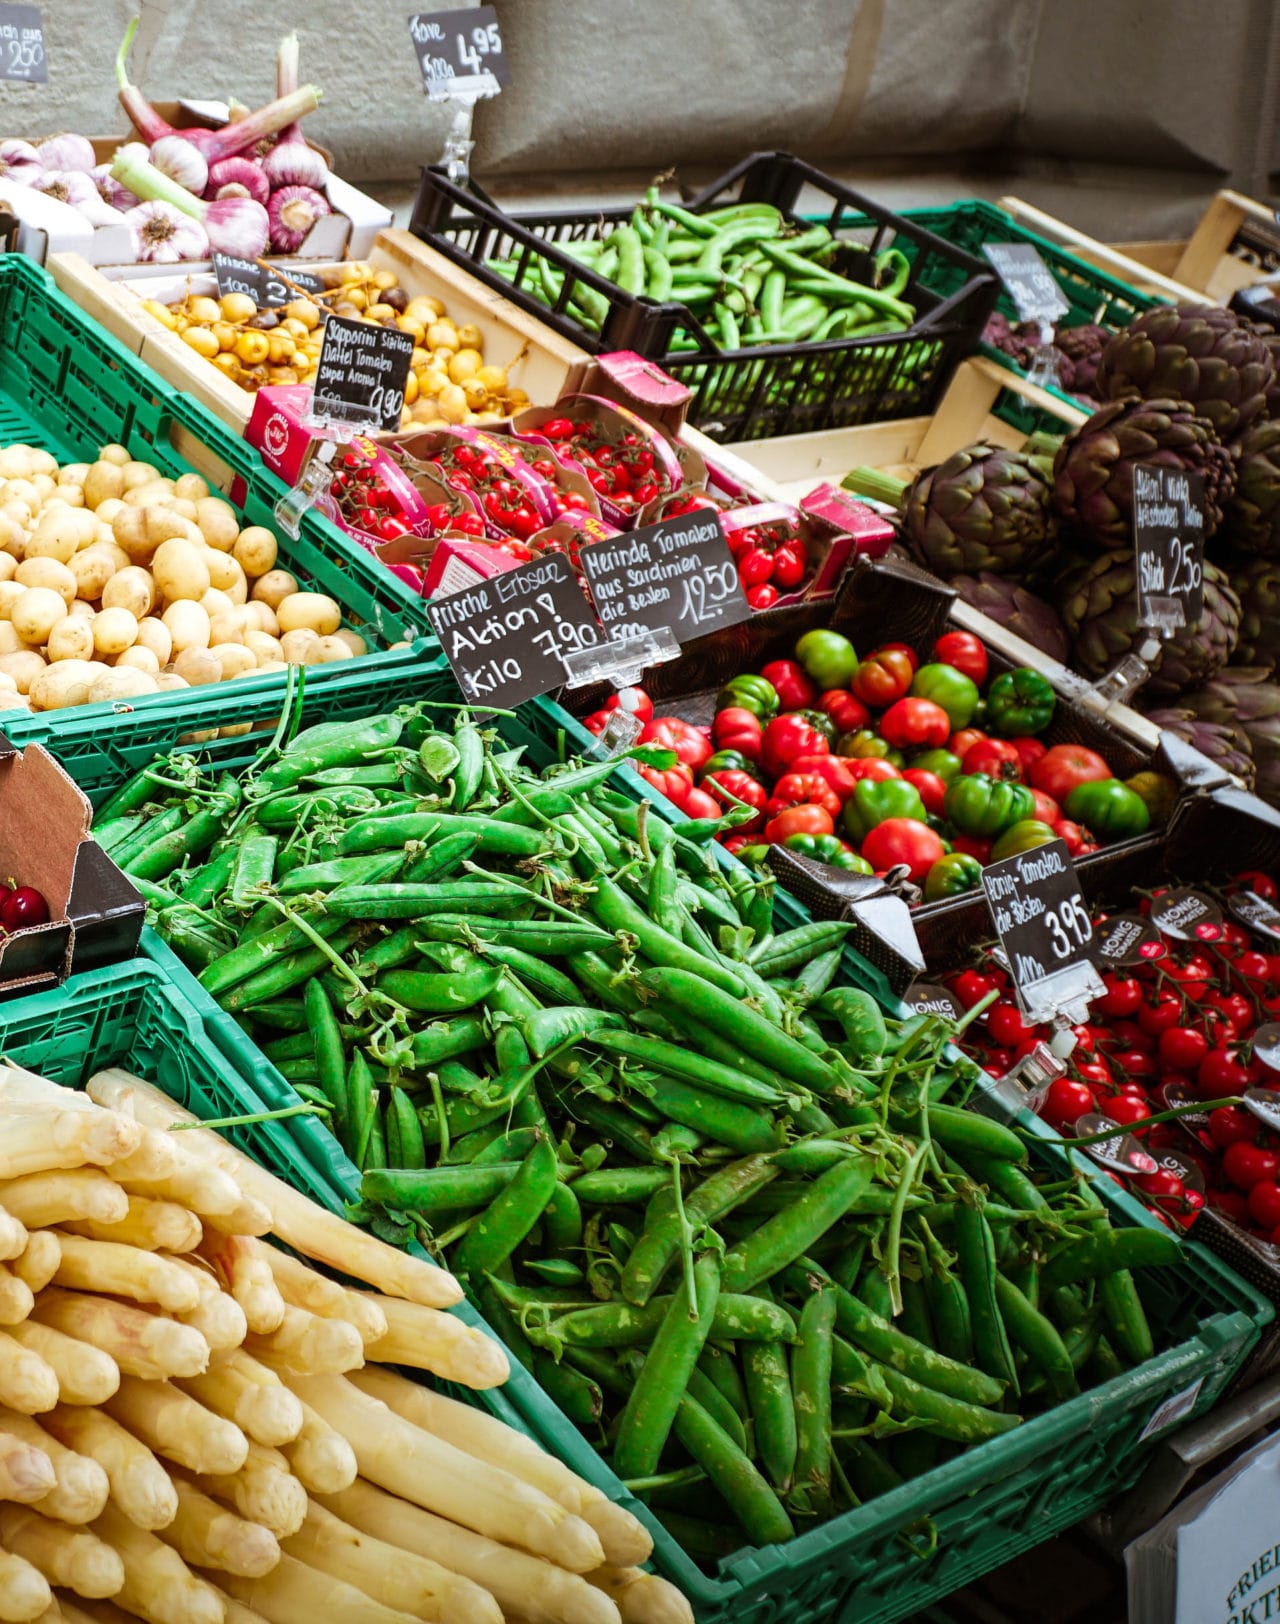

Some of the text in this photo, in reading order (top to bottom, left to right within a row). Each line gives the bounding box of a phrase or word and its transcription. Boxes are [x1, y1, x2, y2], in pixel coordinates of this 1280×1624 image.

[495, 562, 569, 604] Erbsen
[595, 580, 624, 601] aus
[601, 601, 628, 622] die
[464, 657, 522, 698] Kilo
[1044, 893, 1093, 960] 3.95
[1158, 896, 1200, 925] HONIG
[1100, 920, 1132, 956] HONIG
[1111, 924, 1143, 958] TOMATEN
